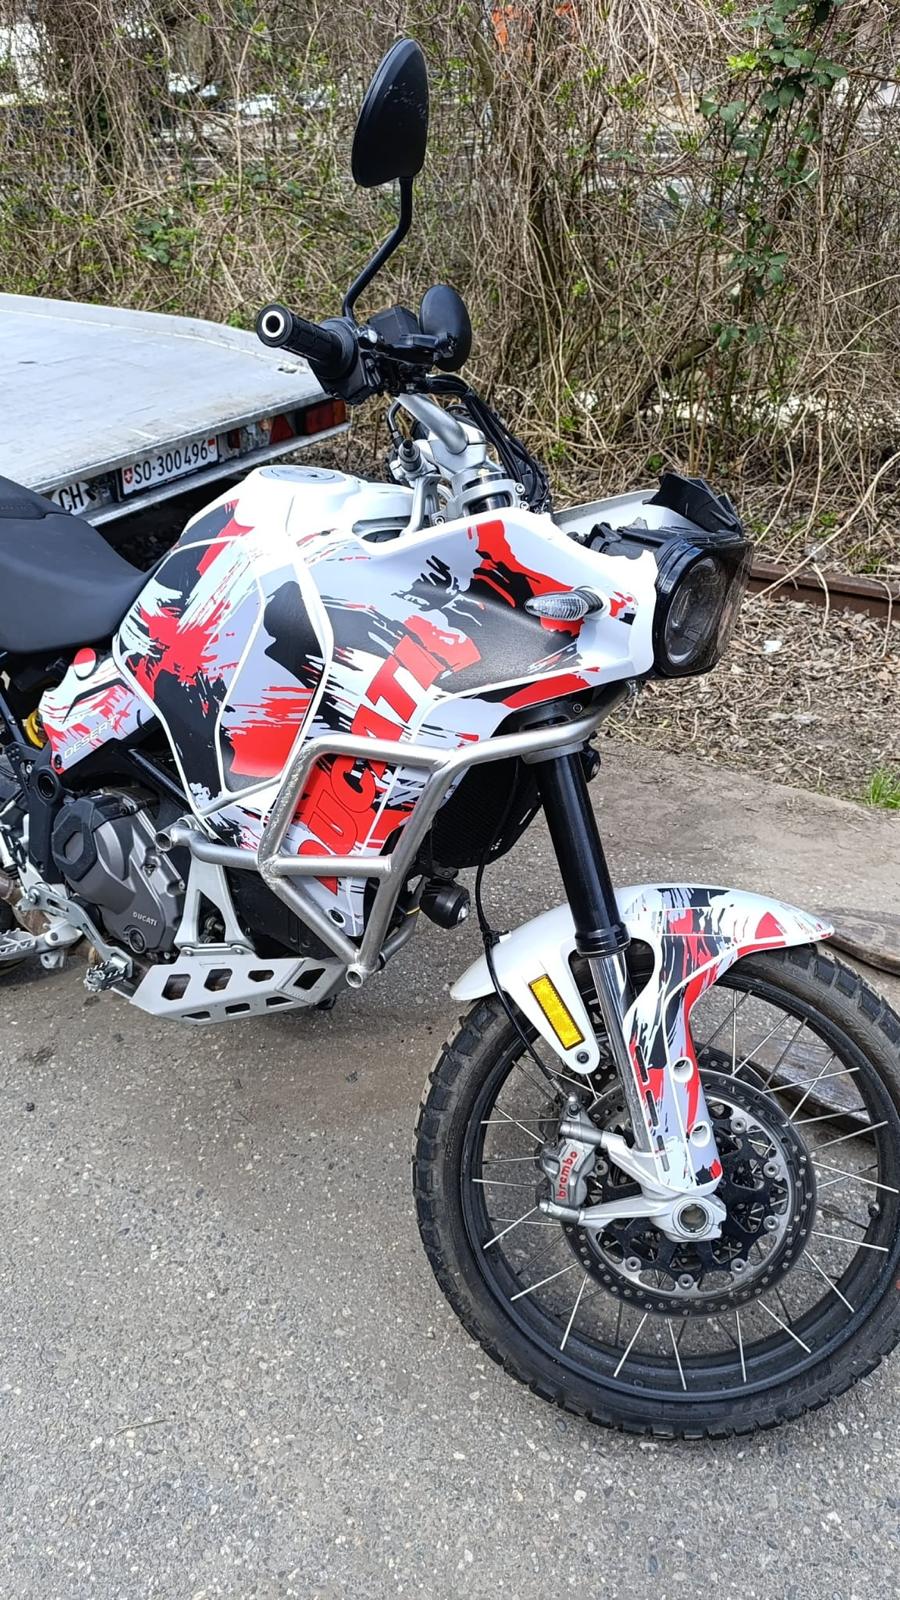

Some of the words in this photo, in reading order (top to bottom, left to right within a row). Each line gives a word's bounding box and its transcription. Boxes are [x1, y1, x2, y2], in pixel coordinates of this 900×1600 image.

[58, 482, 84, 512] CH
[132, 911, 157, 926] DUCATI
[556, 1151, 577, 1199] brembo
